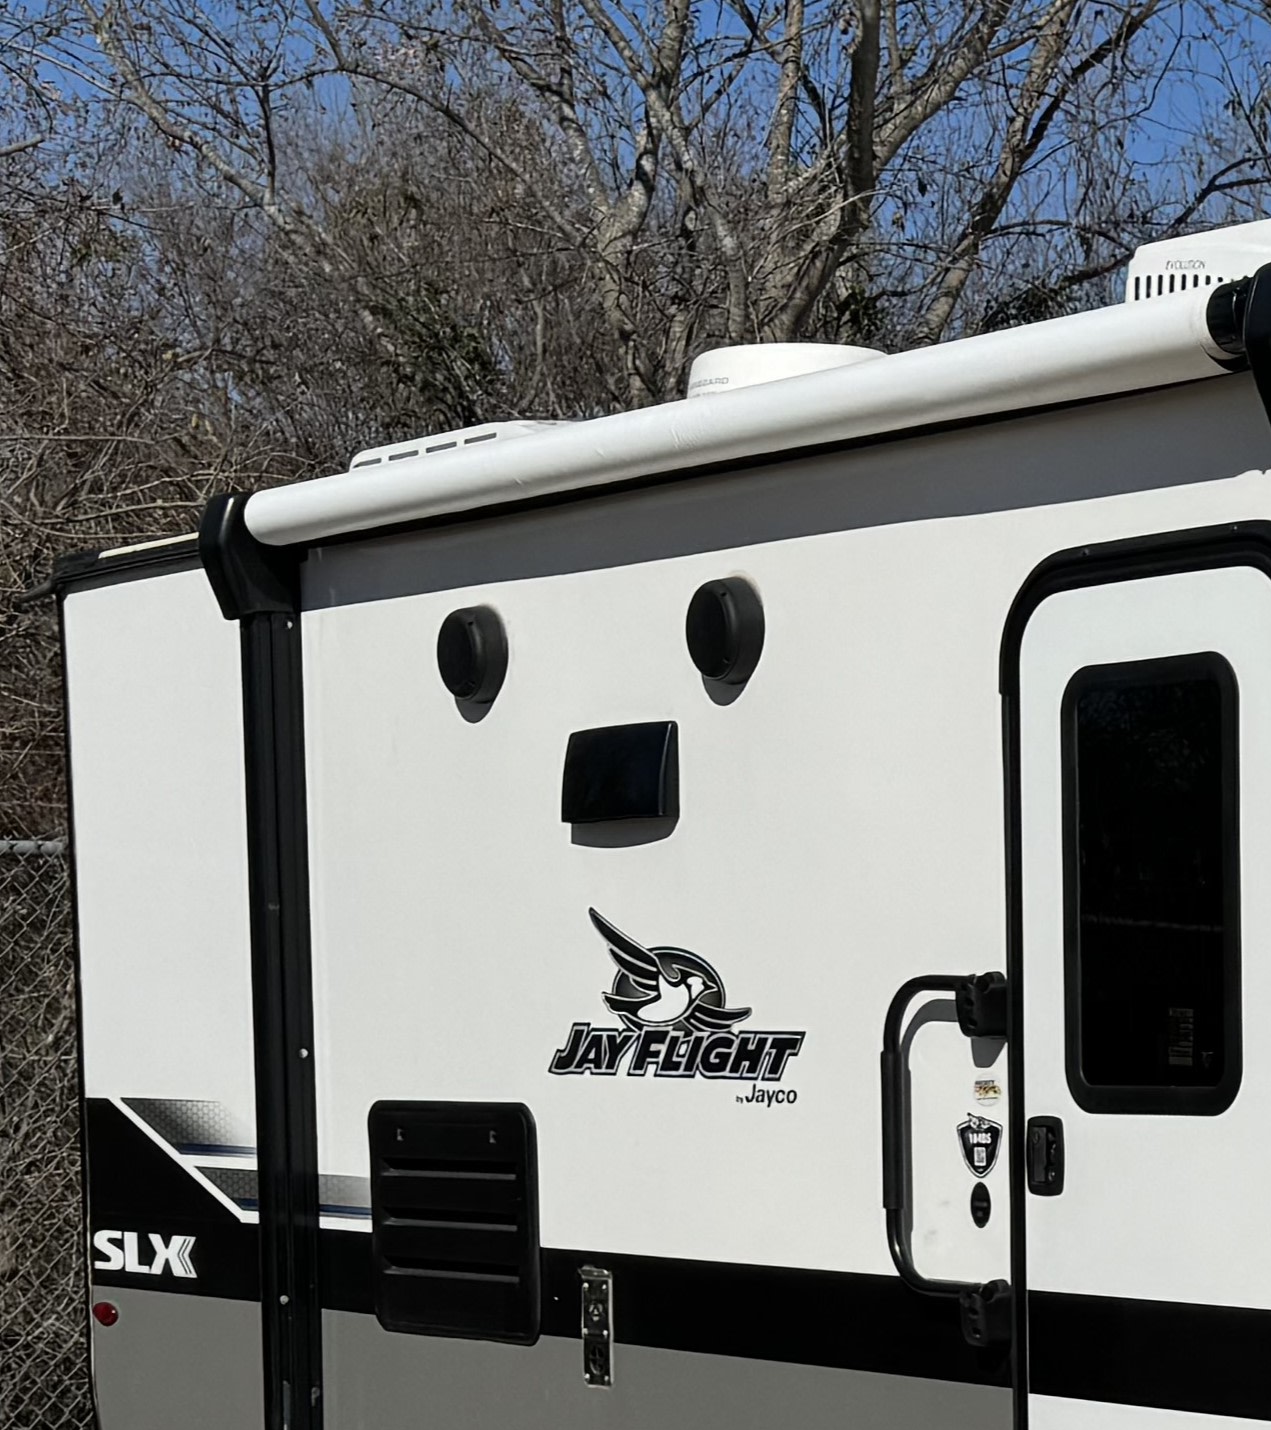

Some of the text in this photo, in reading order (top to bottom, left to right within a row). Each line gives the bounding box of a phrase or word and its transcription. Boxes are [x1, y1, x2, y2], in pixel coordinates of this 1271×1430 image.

[548, 1022, 807, 1082] JAY FLIGHT
[745, 1083, 798, 1108] Jayco
[94, 1229, 198, 1279] SLX
